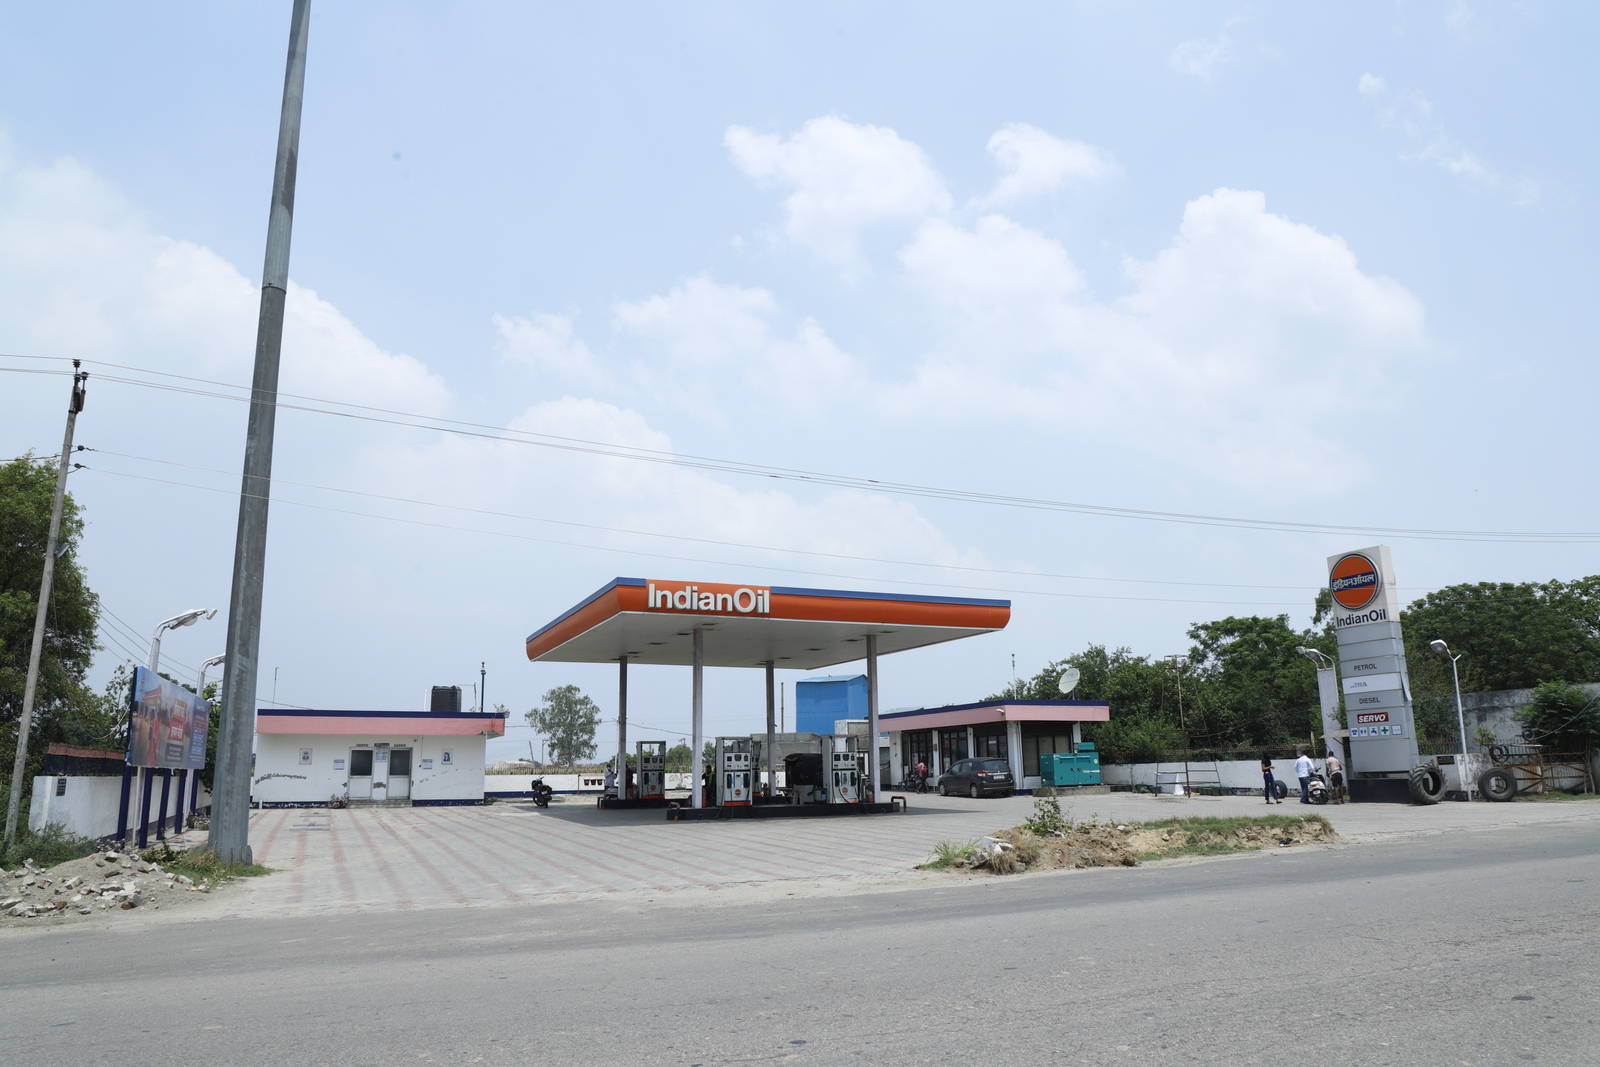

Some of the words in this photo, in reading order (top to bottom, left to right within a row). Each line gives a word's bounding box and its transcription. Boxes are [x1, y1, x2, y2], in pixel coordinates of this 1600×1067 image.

[648, 583, 770, 614] IndianOil
[1336, 608, 1386, 627] IndianOil
[1353, 663, 1377, 671] PETROL
[1358, 714, 1386, 723] SERVO
